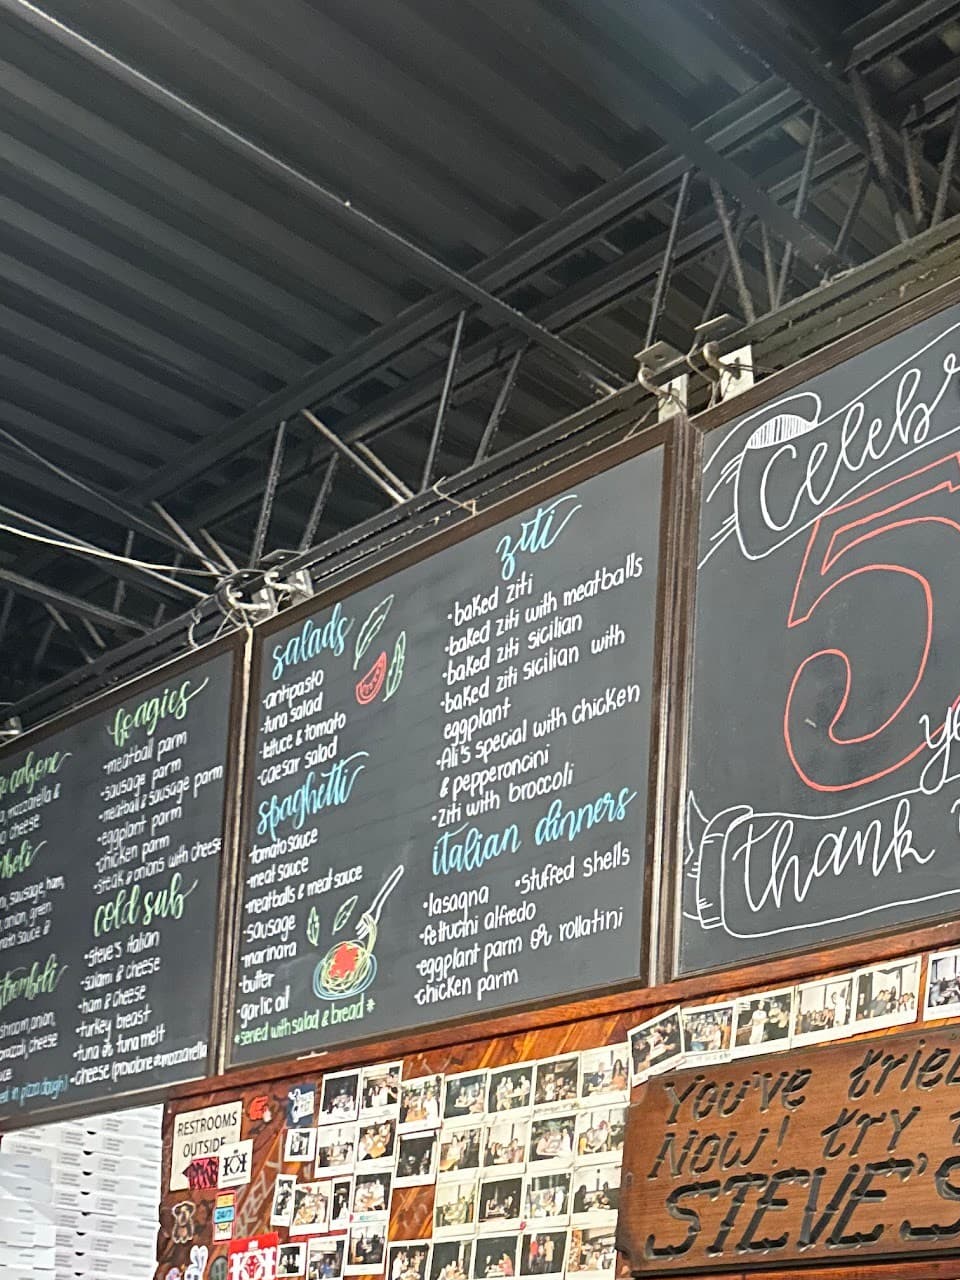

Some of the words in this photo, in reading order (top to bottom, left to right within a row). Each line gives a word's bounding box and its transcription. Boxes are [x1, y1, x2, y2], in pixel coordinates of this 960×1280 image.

[449, 619, 490, 656] baked
[496, 610, 520, 636] ziti
[525, 591, 557, 623] with
[564, 553, 643, 606] meatballs
[455, 586, 498, 626] baked
[506, 571, 533, 604] ziti
[272, 603, 355, 680] salads
[447, 647, 489, 685] baked
[497, 637, 519, 663] ziti
[528, 614, 583, 650] sicilian
[265, 670, 323, 709] antipasto
[444, 675, 489, 713] baked
[496, 666, 518, 692] ziti
[523, 646, 579, 680] sicilian
[591, 624, 625, 654] with
[264, 712, 287, 734] tuna
[290, 692, 323, 722] salad
[305, 712, 346, 739] tomato
[444, 696, 511, 747] eggplant
[475, 719, 527, 764] special
[533, 707, 567, 738] with
[572, 684, 640, 725] chicken
[107, 738, 153, 775] meatball
[158, 731, 187, 761] parm
[260, 757, 300, 786] caesar
[305, 736, 338, 769] salad
[452, 744, 550, 801] pepperoncini
[104, 773, 145, 801] sausage
[153, 758, 181, 789] parm
[149, 777, 190, 804] sausage
[194, 765, 223, 798] parm
[437, 807, 461, 828] ziti
[466, 790, 500, 819] with
[509, 762, 575, 802] broccoli
[101, 815, 147, 854] eggplant
[152, 806, 182, 836] parm
[250, 838, 287, 864] tomato
[287, 828, 318, 852] sauce
[432, 822, 521, 876] italian
[535, 787, 637, 845] dinners
[98, 845, 138, 873] chicken
[142, 835, 170, 862] parm
[134, 857, 165, 880] onions
[168, 845, 188, 868] with
[191, 837, 222, 862] cheese
[250, 869, 275, 888] meat
[278, 856, 309, 880] sauce
[94, 884, 141, 937] cold
[143, 872, 198, 925] sub
[247, 884, 295, 913] meatballs
[307, 868, 332, 896] meat
[334, 865, 363, 888] sauce
[428, 886, 489, 923] lasagna
[247, 914, 296, 943] sausage
[484, 902, 536, 931] alfredo
[127, 931, 160, 953] italian
[244, 941, 297, 967] marinara
[420, 946, 480, 982] eggplant
[484, 935, 522, 972] parm
[530, 923, 552, 950] or
[559, 907, 624, 941] rollatini
[84, 971, 113, 990] salami
[242, 970, 275, 993] butter
[418, 975, 471, 1006] chicken
[477, 968, 518, 1000] parm
[81, 1015, 112, 1042] turkey
[116, 1004, 152, 1028] breast
[83, 993, 101, 1013] ham
[240, 996, 272, 1029] garlic
[275, 984, 290, 1010] oil
[292, 1010, 319, 1035] salad
[332, 993, 364, 1025] bread
[78, 1044, 99, 1062] tuna
[116, 1034, 140, 1053] tuna
[141, 1023, 165, 1045] melt
[664, 1068, 813, 1125] You've
[178, 1111, 237, 1137] RESTROOMS
